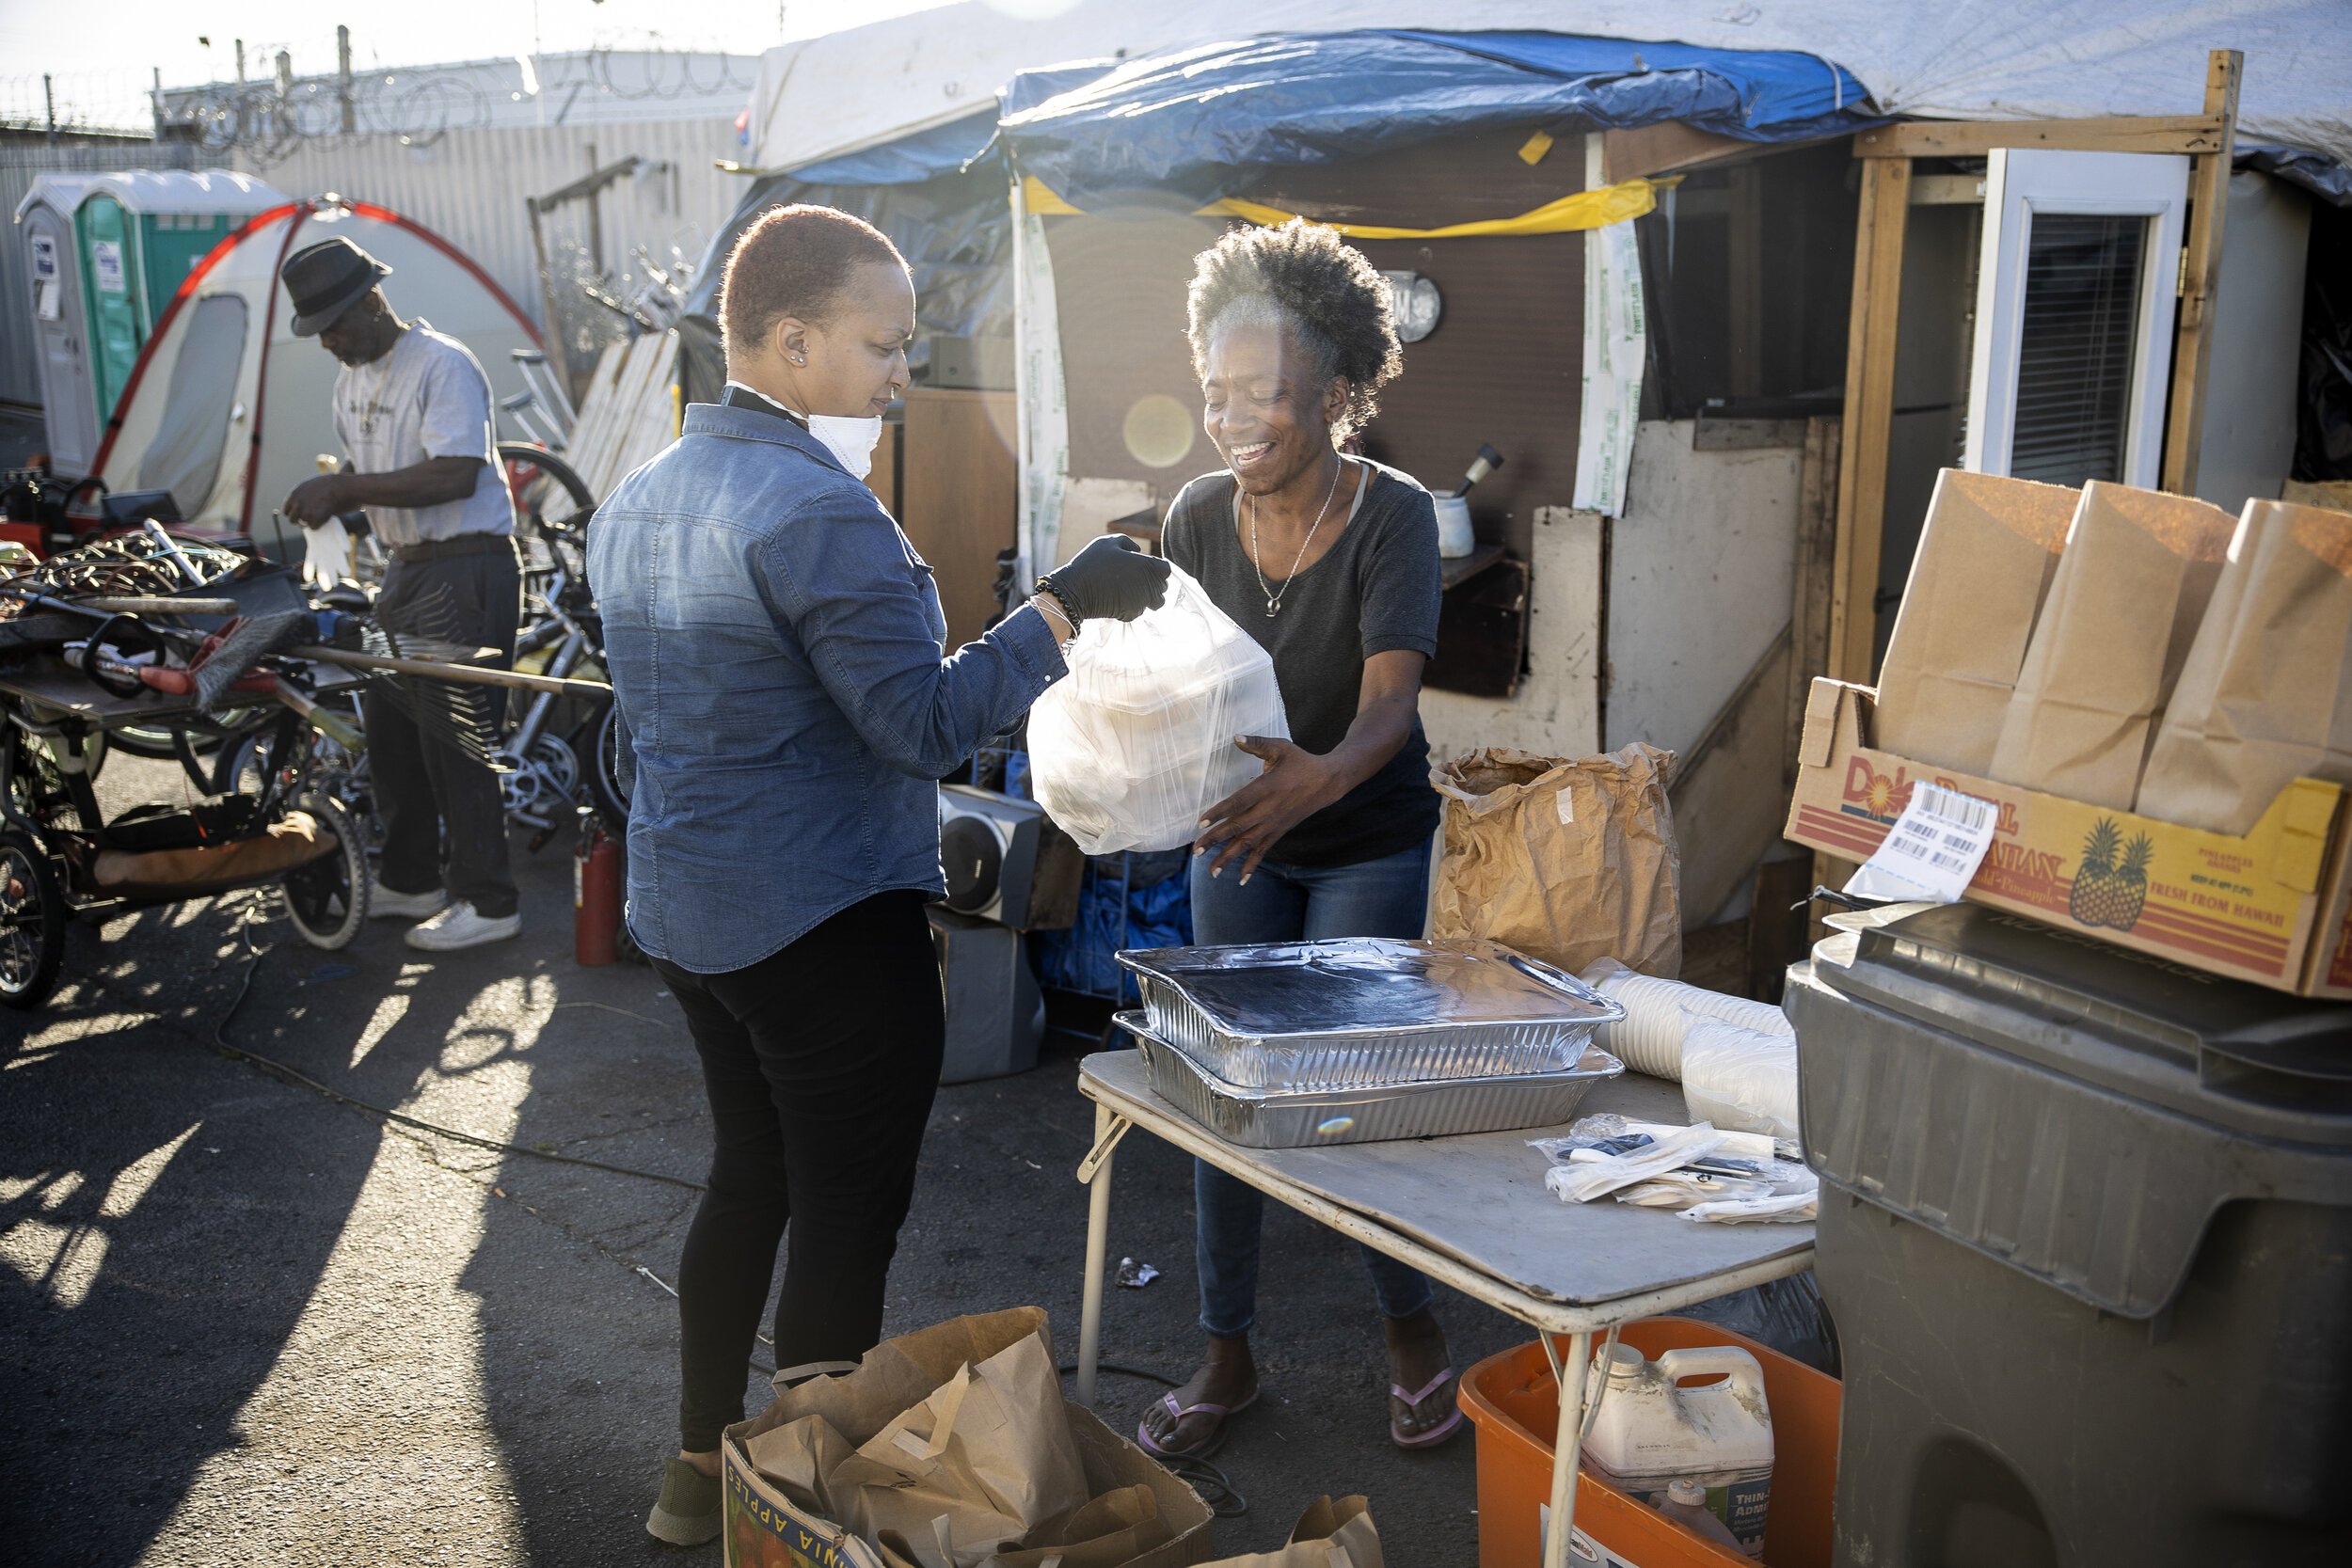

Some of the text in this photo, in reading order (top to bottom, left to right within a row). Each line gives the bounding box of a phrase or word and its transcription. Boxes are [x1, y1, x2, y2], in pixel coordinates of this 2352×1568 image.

[2150, 881, 2285, 928] FRESH FROM HAWAII
[727, 1465, 788, 1533] APPLES
